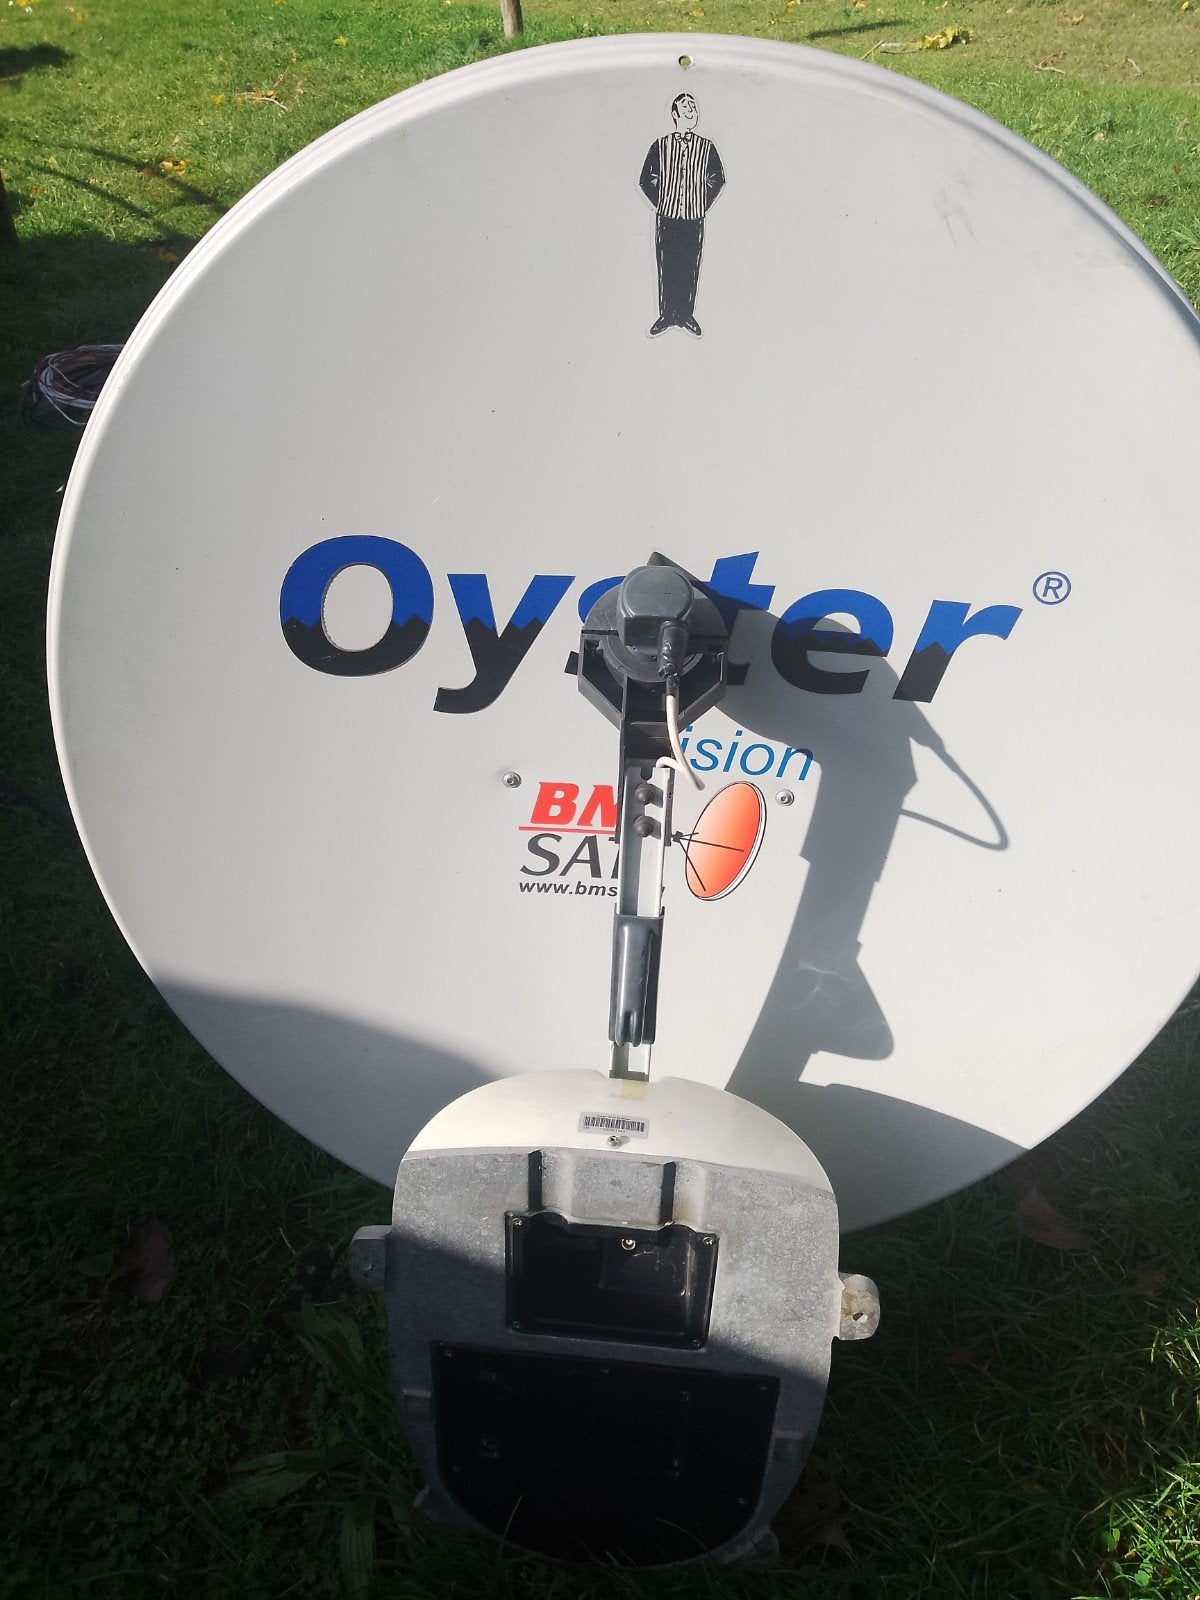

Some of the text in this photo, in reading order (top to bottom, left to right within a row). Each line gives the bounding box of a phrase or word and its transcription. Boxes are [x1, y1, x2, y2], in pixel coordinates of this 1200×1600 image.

[681, 725, 814, 781] ision
[530, 781, 618, 828] BM
[519, 880, 665, 898] www.bms
